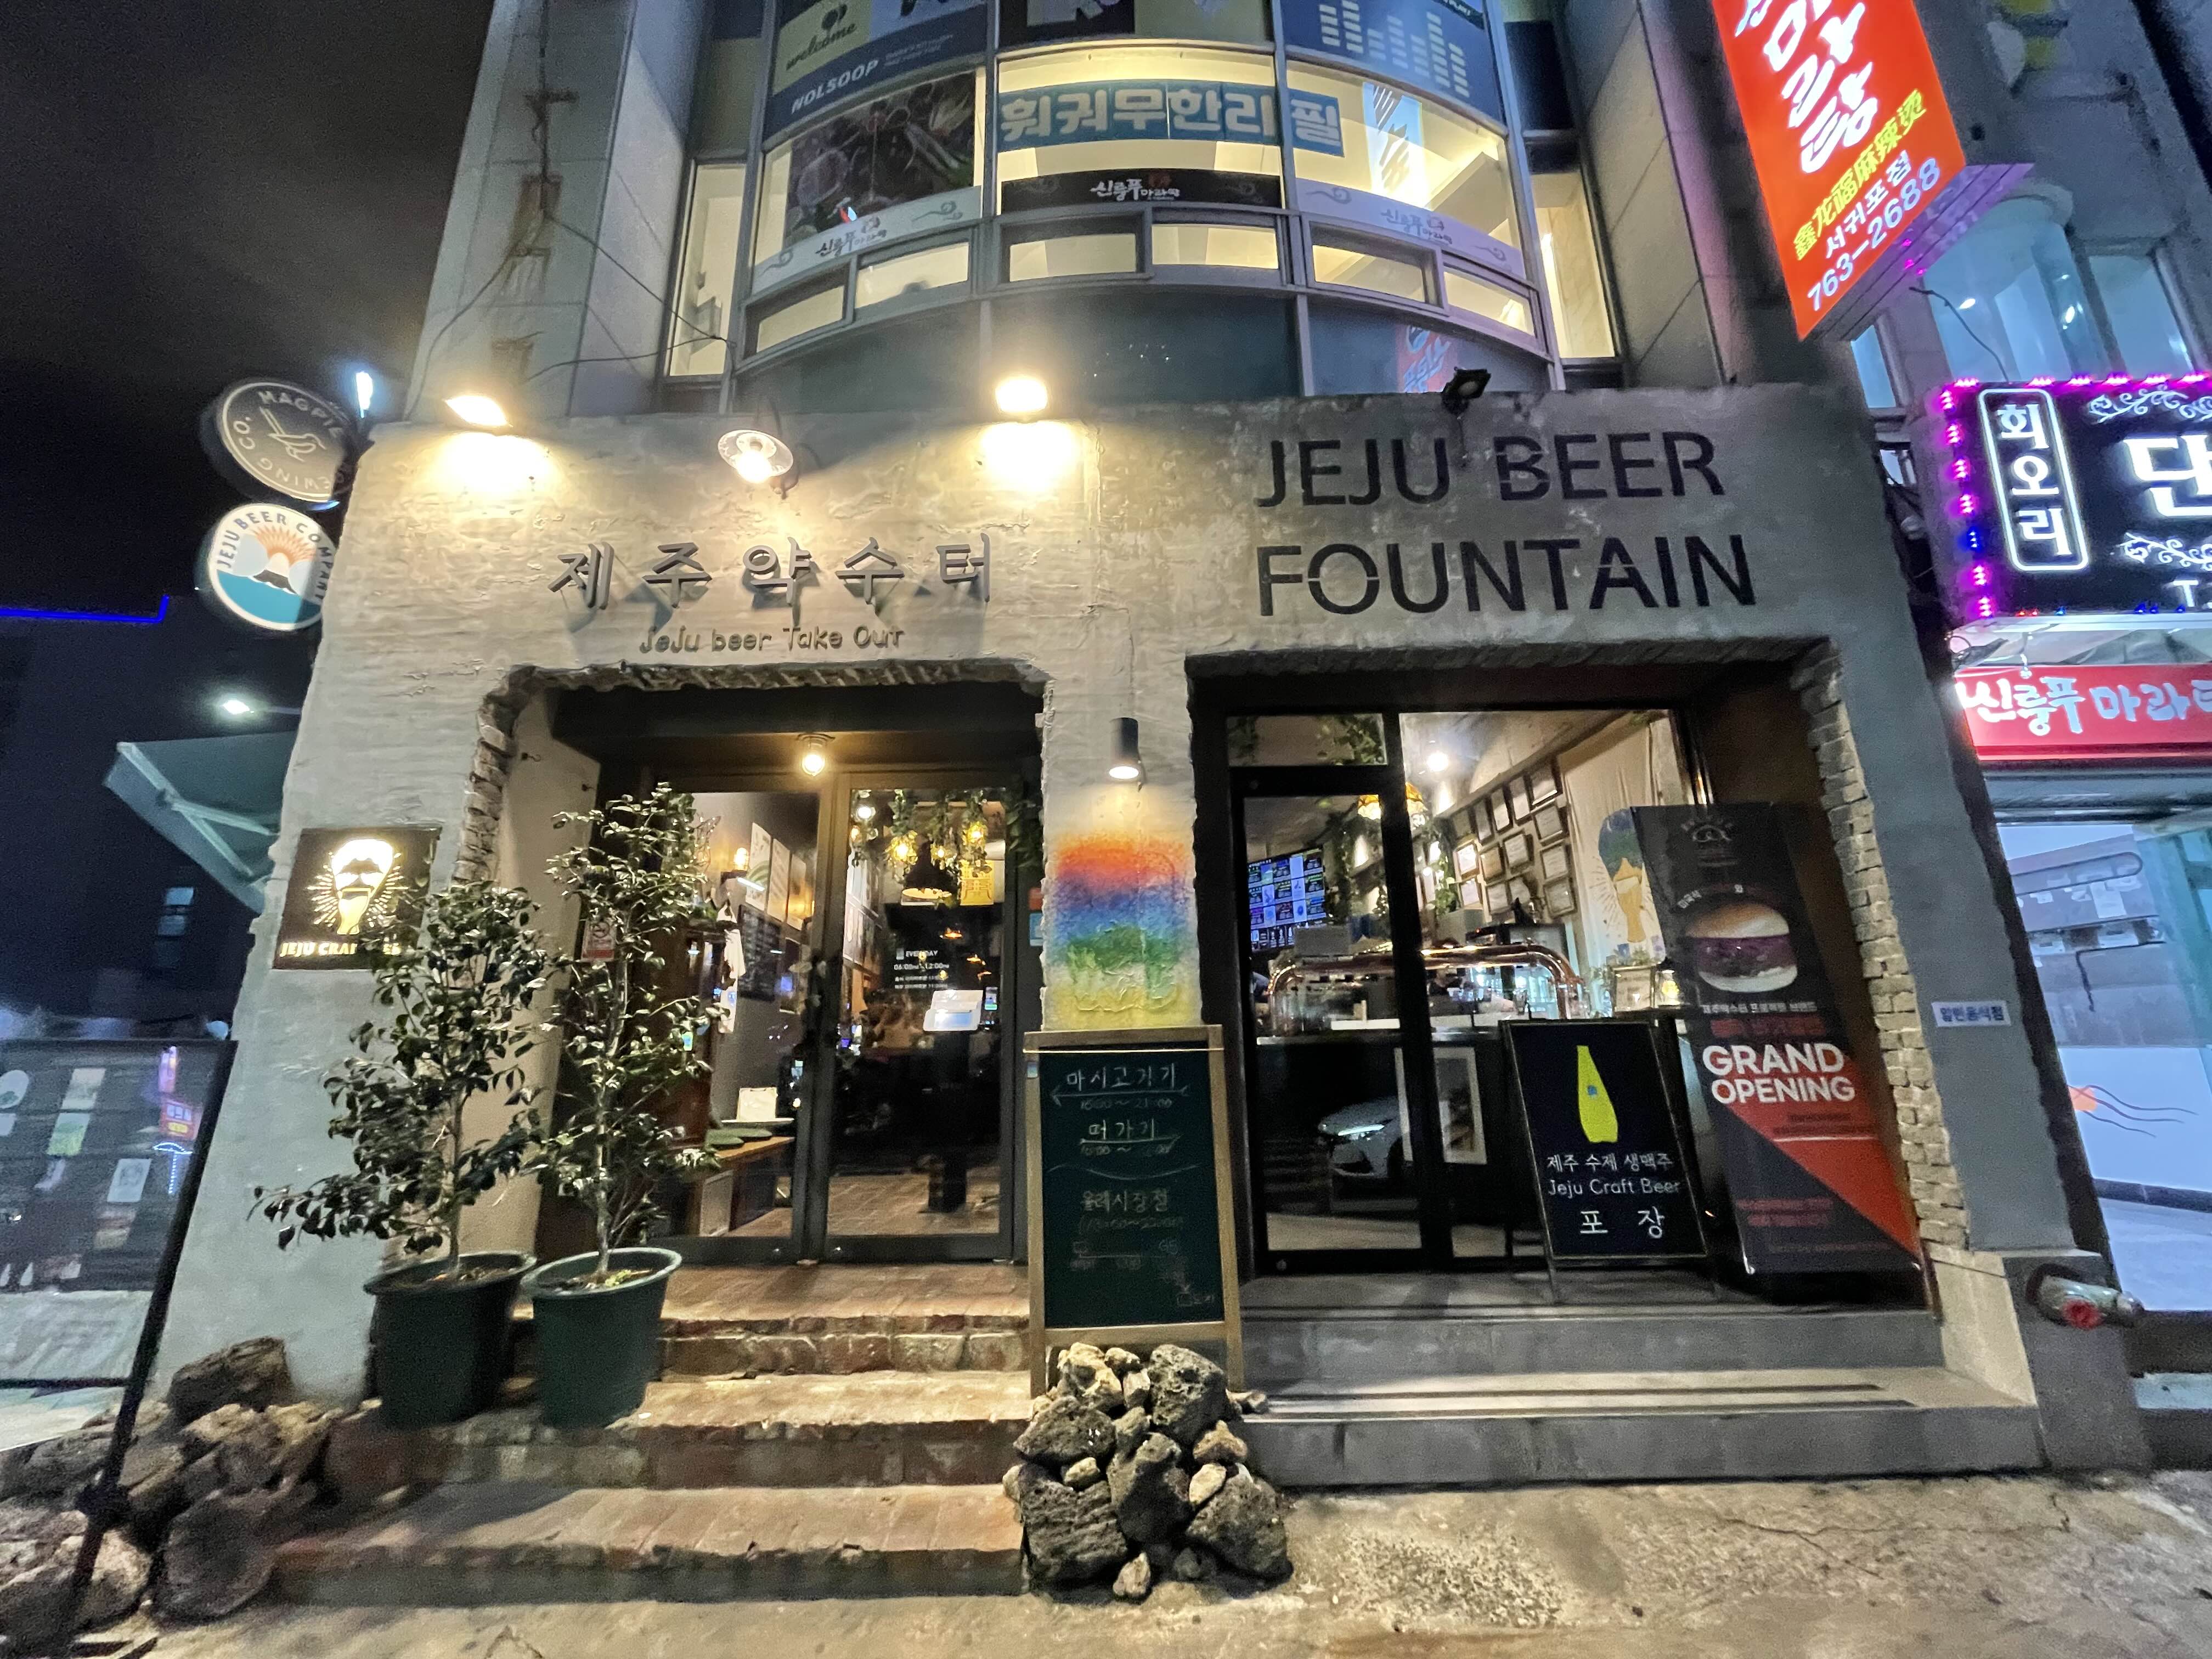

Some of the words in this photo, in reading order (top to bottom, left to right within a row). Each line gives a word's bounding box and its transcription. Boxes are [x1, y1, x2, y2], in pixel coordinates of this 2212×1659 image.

[786, 23, 857, 71] welcome
[1826, 150, 1911, 258] 서귀포점
[1808, 158, 1940, 311] 763-2688
[1254, 439, 1450, 507] JEJU
[1493, 431, 1725, 501] BEER
[1997, 404, 2072, 555] 회오리
[217, 531, 241, 569] JEJU
[234, 511, 287, 531] BEER
[549, 533, 991, 610] 제주약수터
[1256, 533, 1757, 617] FOUNTAIN
[711, 629, 772, 652] beer
[783, 626, 843, 651] Take
[280, 942, 316, 957] JEJU
[1702, 1043, 1844, 1076] GRAND
[1711, 1076, 1856, 1104] OPENING
[1547, 1153, 1578, 1172] 제주
[1584, 1153, 1617, 1172] 수제
[1624, 1153, 1673, 1172] 생맥주
[1549, 1179, 1583, 1199] Jeju
[1589, 1178, 1635, 1195] Craft
[1640, 1177, 1680, 1194] Beer
